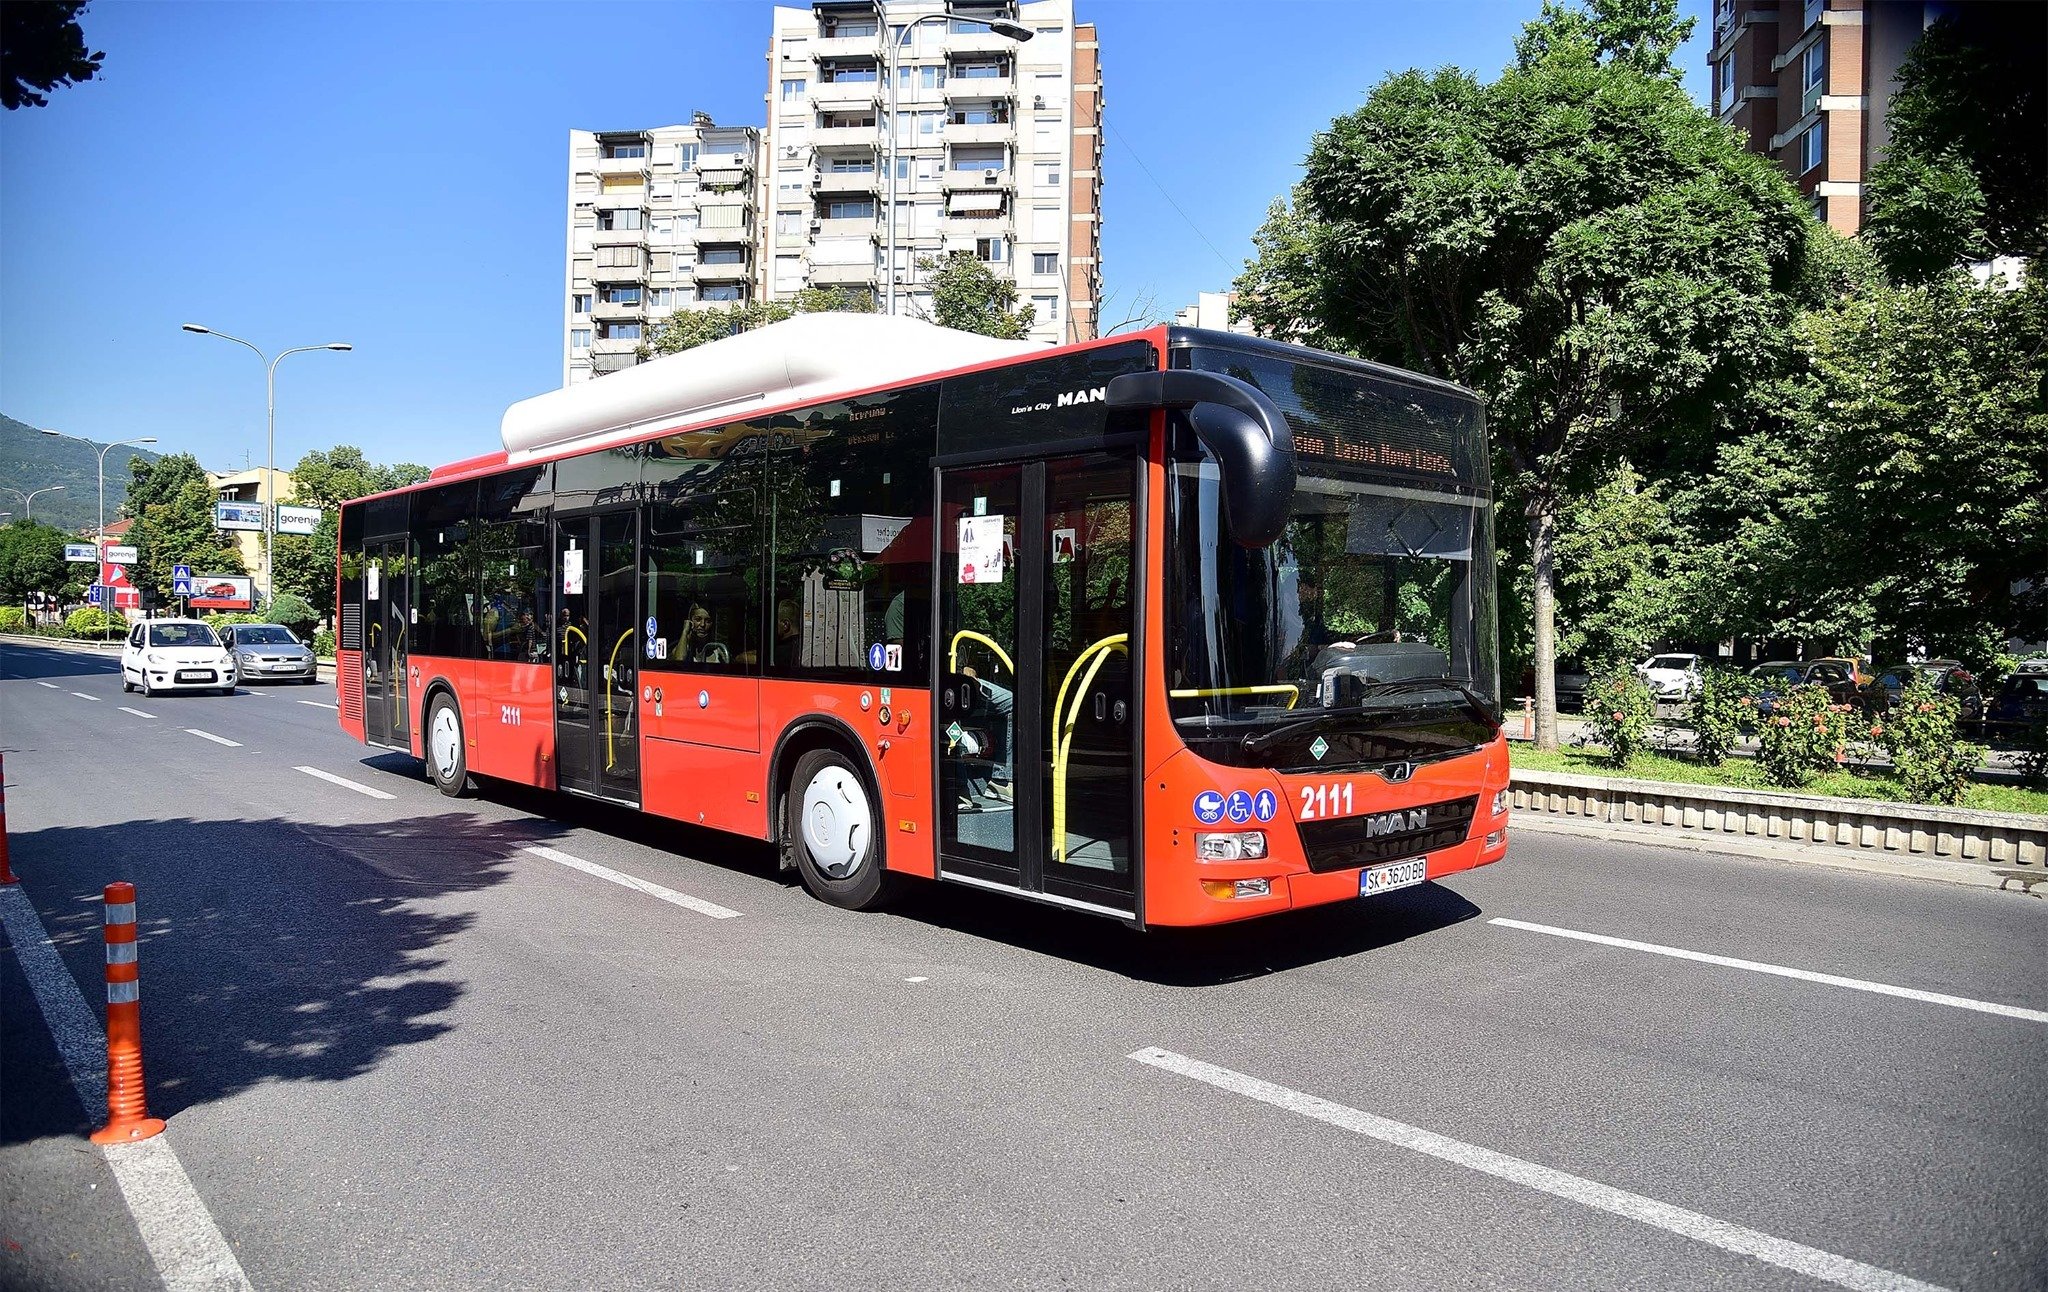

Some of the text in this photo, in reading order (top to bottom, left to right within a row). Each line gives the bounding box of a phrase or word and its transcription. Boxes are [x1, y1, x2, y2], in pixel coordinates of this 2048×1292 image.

[1011, 386, 1106, 414] Lion's City MAN
[280, 515, 320, 525] gorenje
[502, 704, 521, 726] 2111
[1300, 781, 1353, 819] 2111
[1366, 808, 1428, 838] MAN
[1368, 861, 1424, 889] SK 3620 BB
